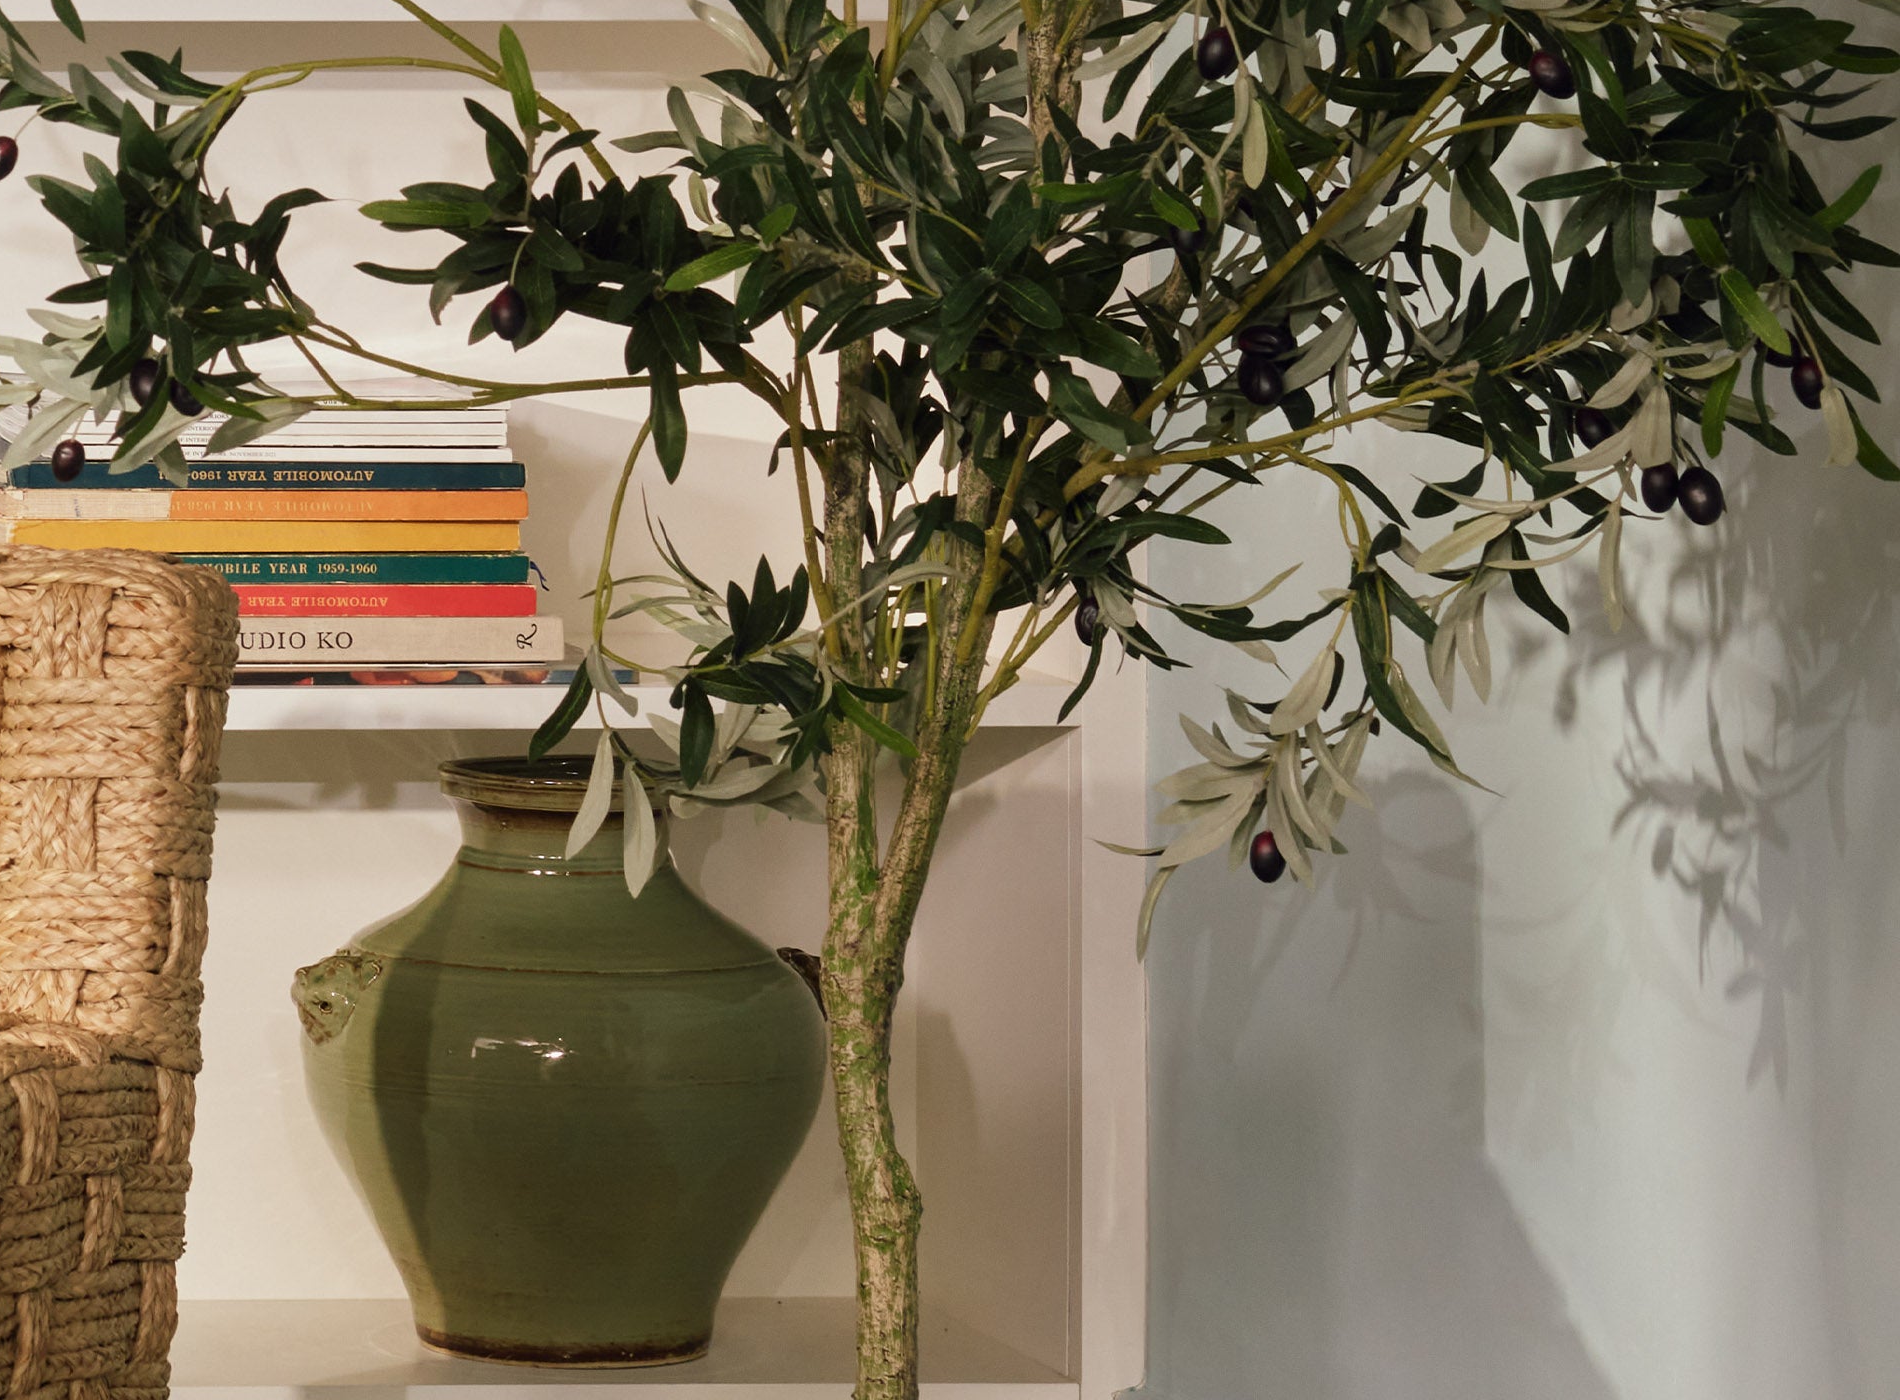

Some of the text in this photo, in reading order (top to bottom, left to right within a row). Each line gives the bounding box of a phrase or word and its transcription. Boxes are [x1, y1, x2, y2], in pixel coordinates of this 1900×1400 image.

[227, 470, 374, 481] AUTOMOBILE YEAR
[225, 501, 373, 511] AUTOMOBILE YEAR
[270, 563, 378, 575] YEAR 1959-1960
[248, 597, 388, 607] AUTOMOBILE YEAR
[240, 631, 353, 649] UDIO KO
